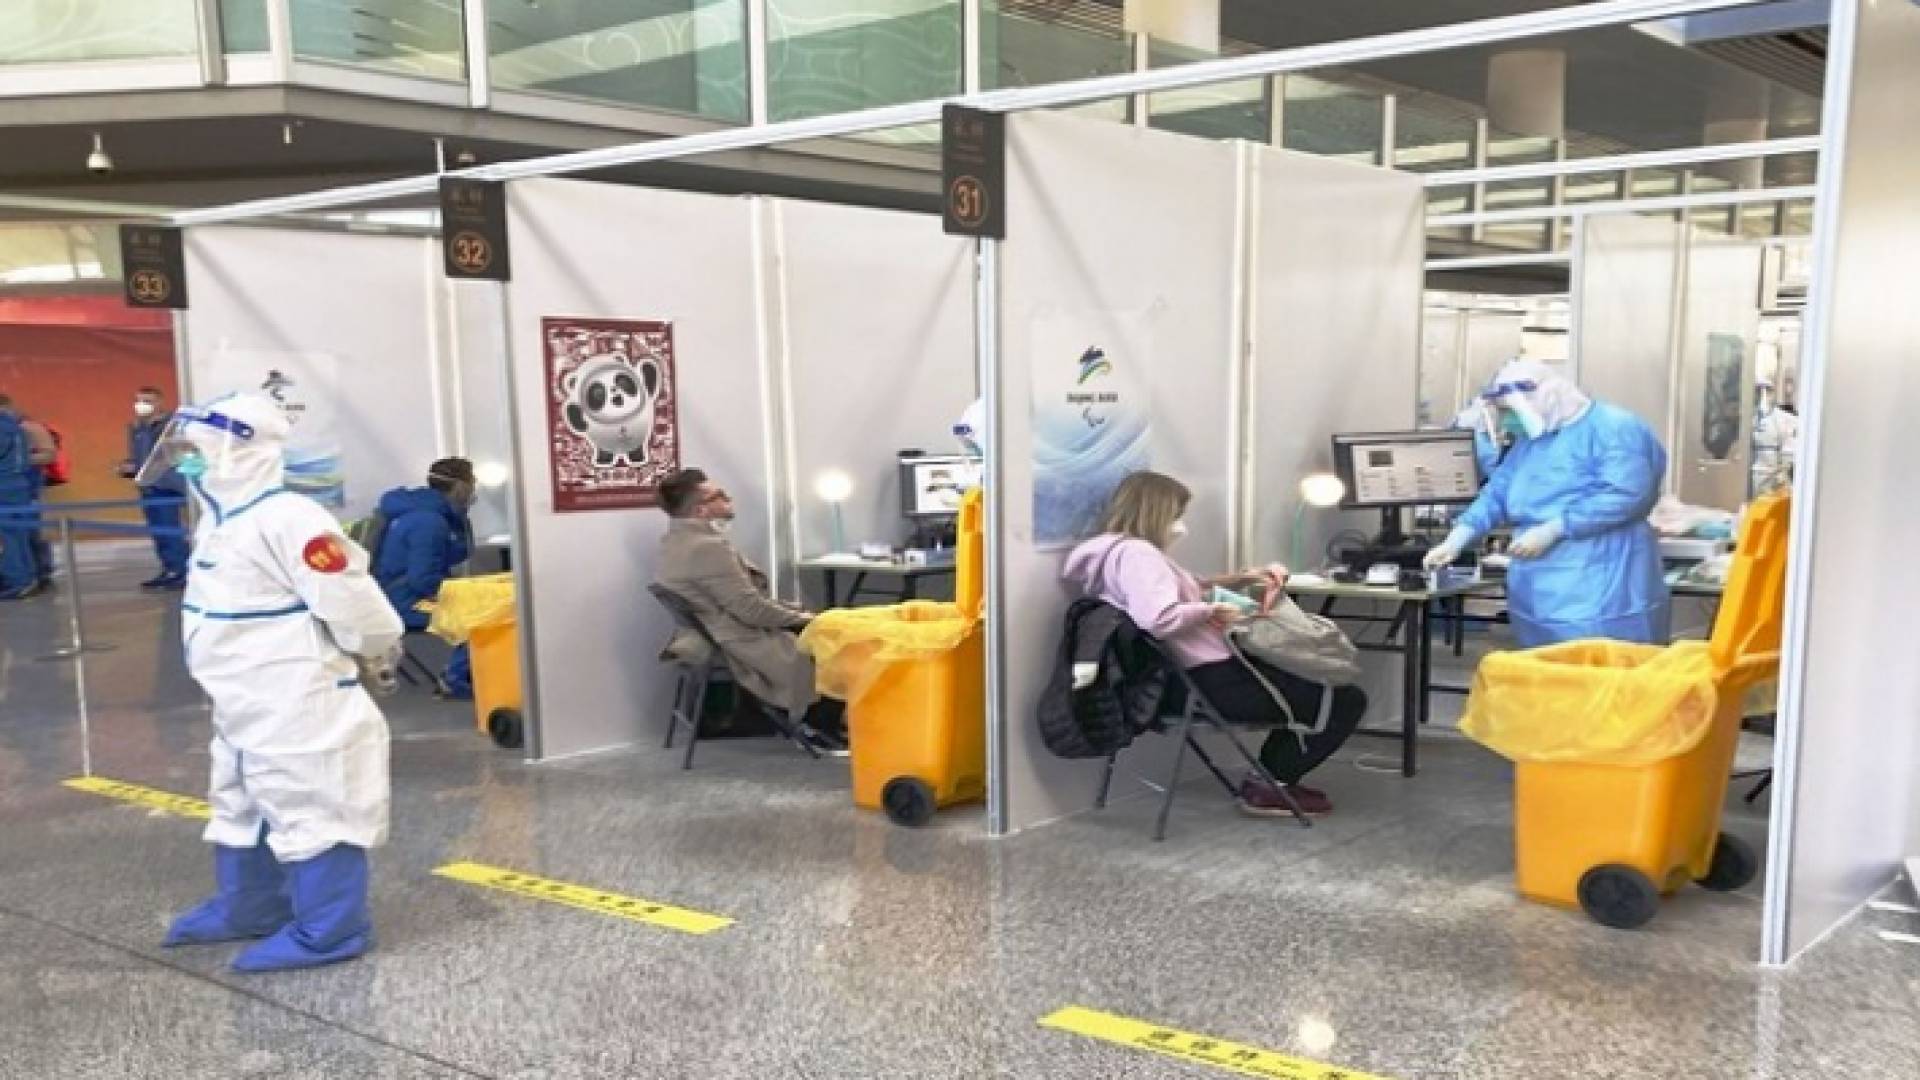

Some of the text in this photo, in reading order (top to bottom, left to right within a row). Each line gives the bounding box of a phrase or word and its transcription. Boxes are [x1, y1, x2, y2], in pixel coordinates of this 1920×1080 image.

[957, 184, 981, 217] 31
[456, 239, 485, 265] 32
[136, 275, 163, 297] 33
